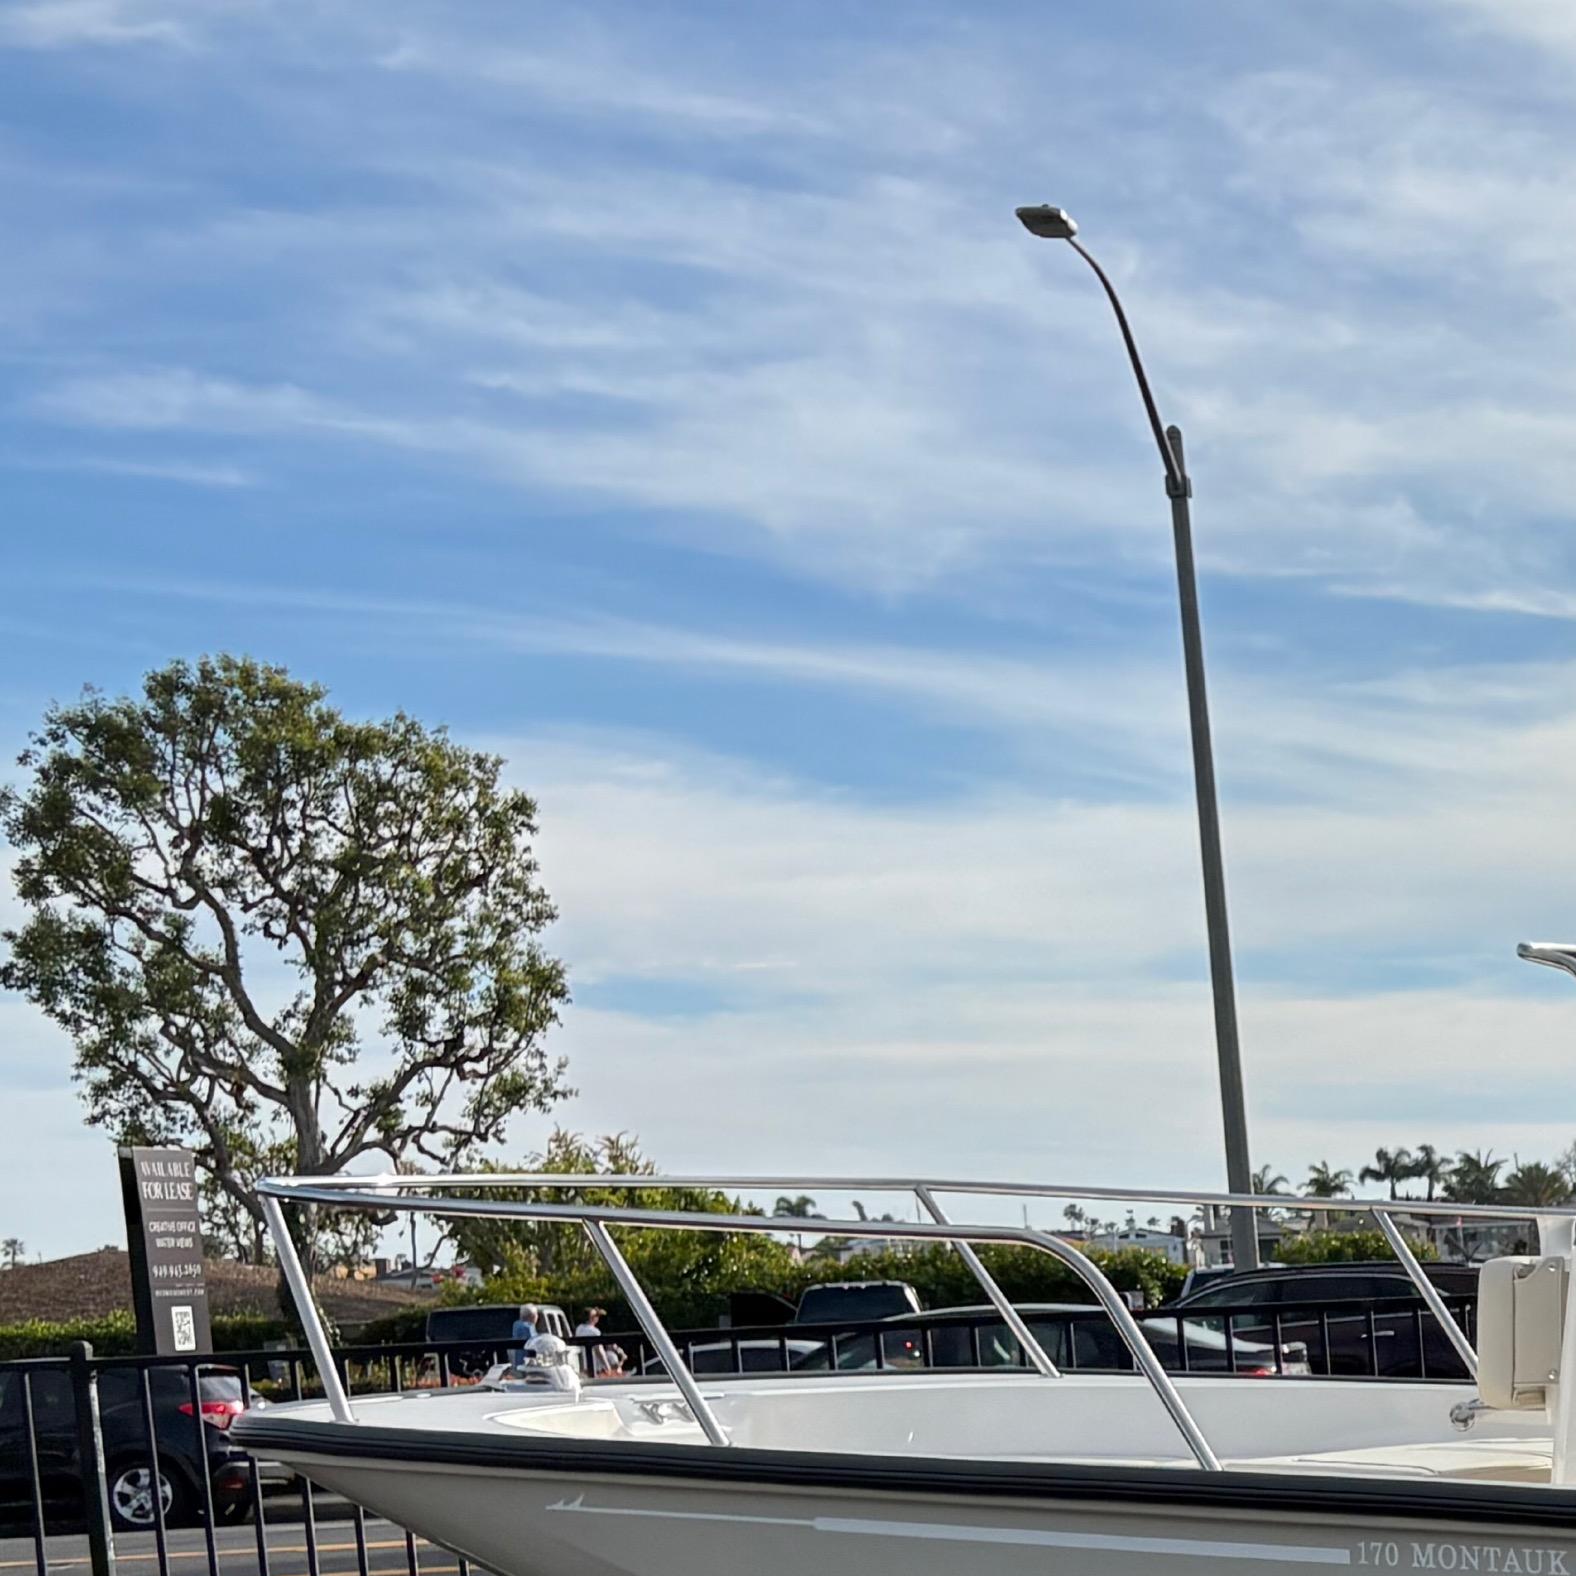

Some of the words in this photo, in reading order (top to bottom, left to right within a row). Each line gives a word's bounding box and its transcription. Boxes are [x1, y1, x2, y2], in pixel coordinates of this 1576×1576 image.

[139, 1161, 191, 1178] AVAILABLE
[142, 1181, 164, 1200] FOR
[164, 1181, 194, 1201] LEASE
[1356, 1541, 1399, 1567] 170
[1410, 1543, 1571, 1576] MONTAUK
